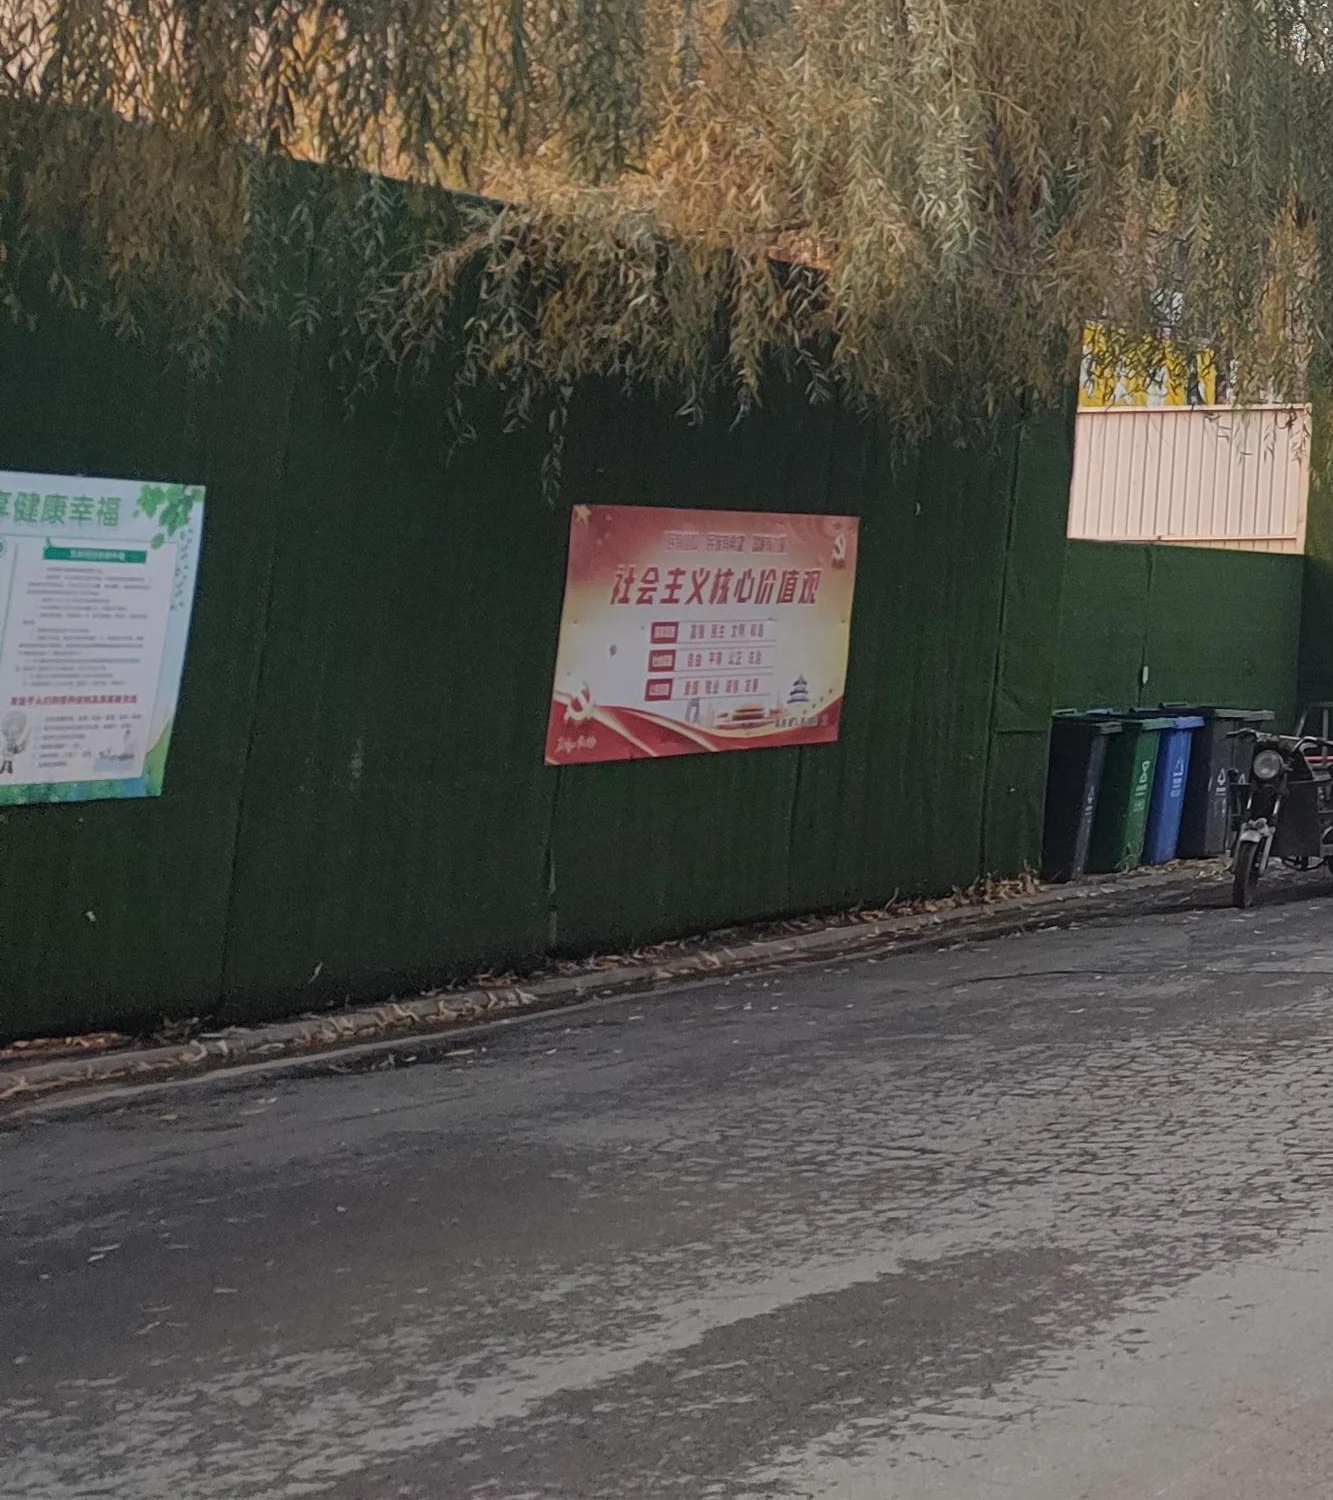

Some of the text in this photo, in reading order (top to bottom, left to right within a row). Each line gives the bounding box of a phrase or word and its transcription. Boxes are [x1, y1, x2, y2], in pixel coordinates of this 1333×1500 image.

[610, 563, 822, 605] 社会主义核心价值观
